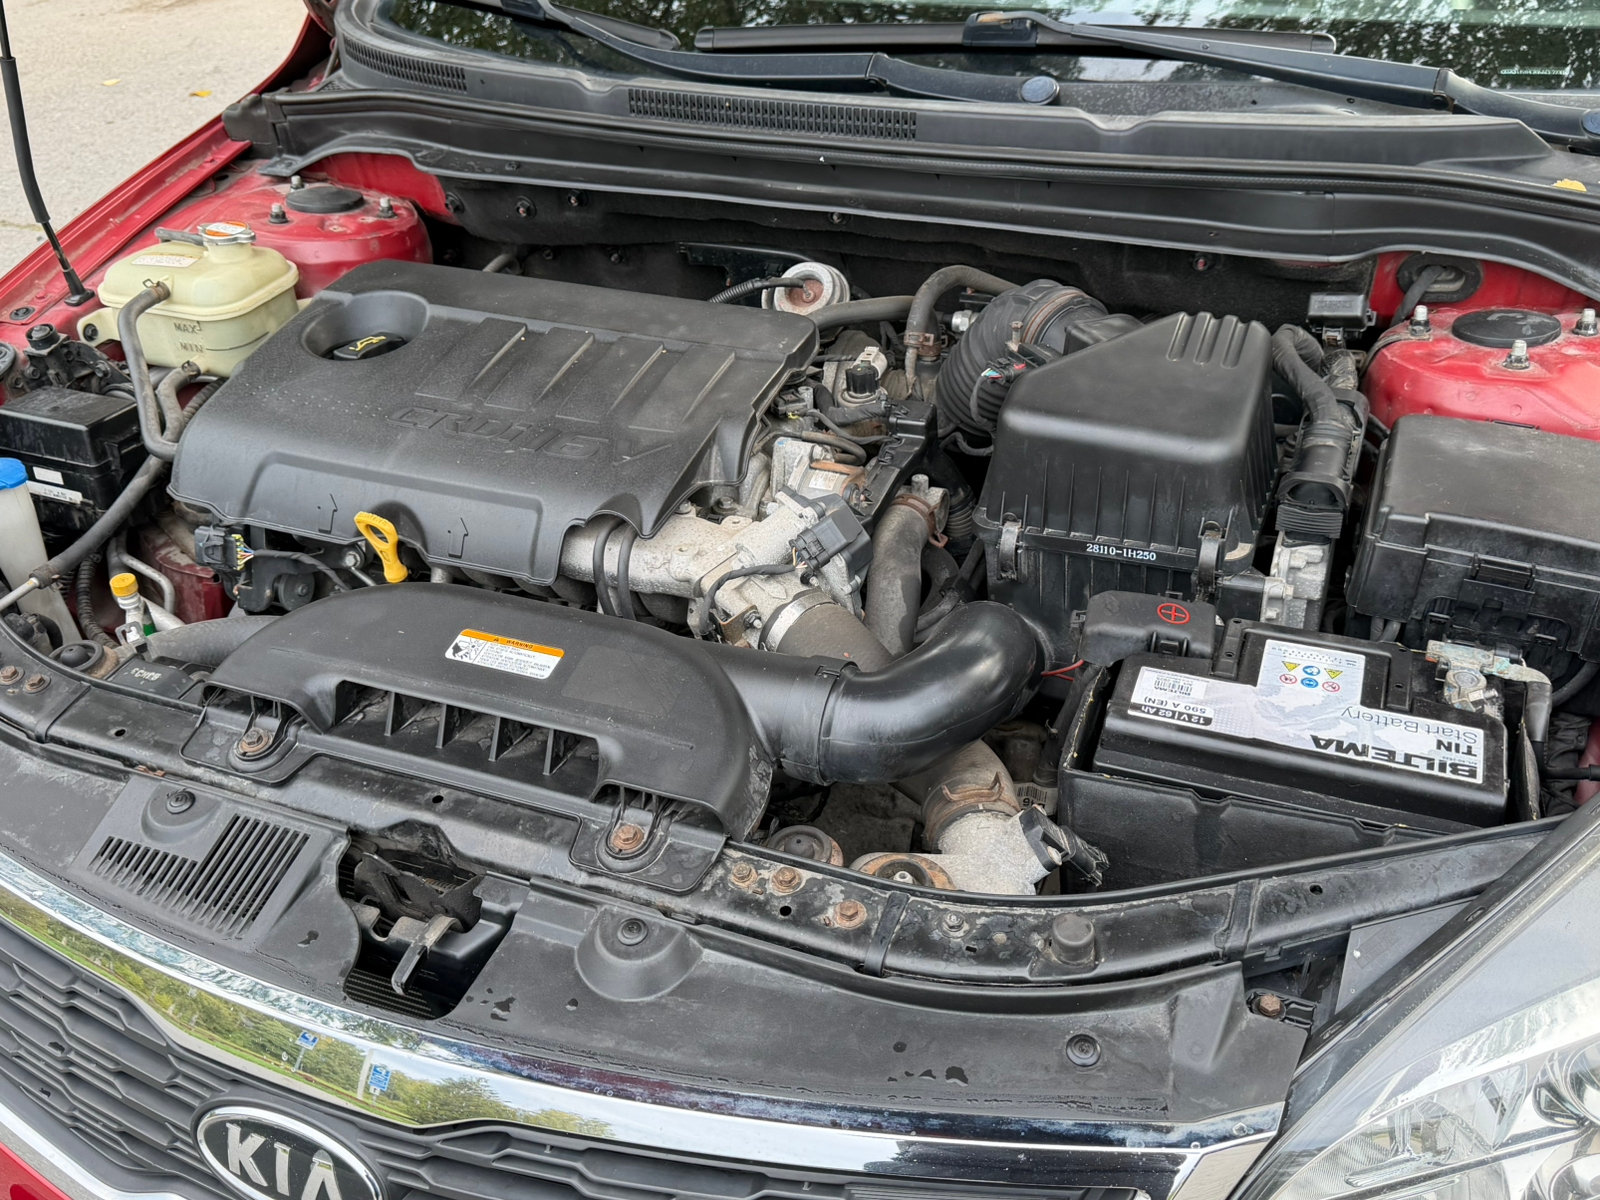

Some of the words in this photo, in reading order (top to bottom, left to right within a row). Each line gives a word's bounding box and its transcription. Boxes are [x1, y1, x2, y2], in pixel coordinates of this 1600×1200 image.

[173, 322, 198, 334] MAX
[179, 341, 203, 354] MIN
[1086, 543, 1157, 561] 28110-1H250
[506, 639, 534, 650] WARNING
[1144, 696, 1168, 707] (EN)
[1141, 705, 1158, 714] Ah
[1158, 709, 1173, 718] 62
[1184, 705, 1207, 715] 590
[1180, 713, 1189, 721] V
[1191, 715, 1205, 724] 12
[1341, 706, 1419, 733] Battery
[1425, 724, 1478, 745] Start
[1436, 739, 1478, 757] TIN
[1310, 734, 1478, 780] BILTEMA
[225, 1122, 343, 1200] KIA
